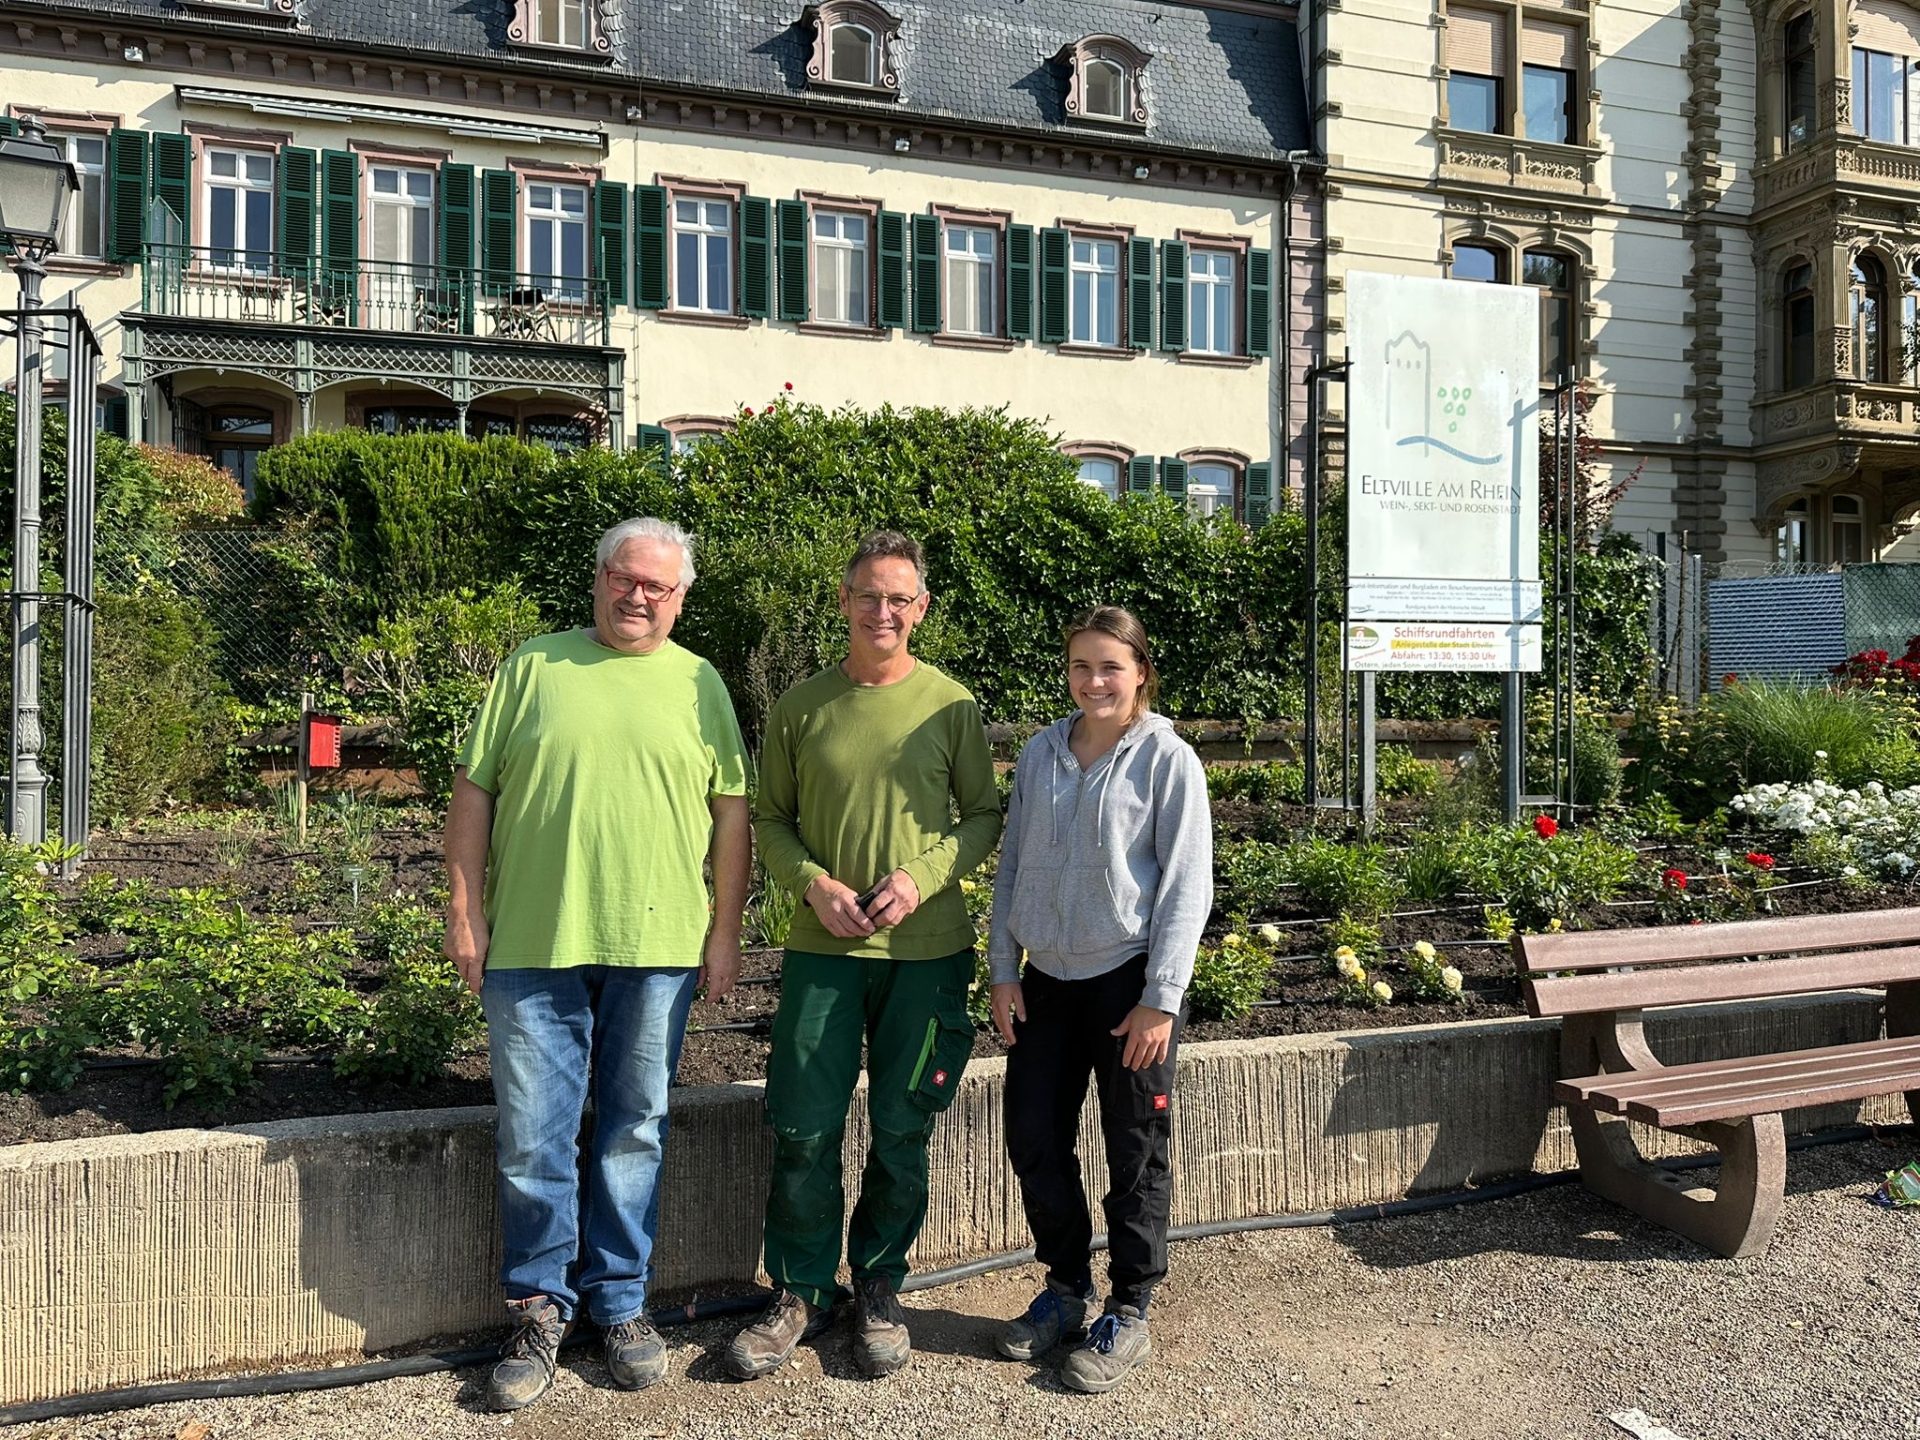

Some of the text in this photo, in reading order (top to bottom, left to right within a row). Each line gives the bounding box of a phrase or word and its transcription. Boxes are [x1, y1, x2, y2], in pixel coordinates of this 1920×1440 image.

[1413, 501, 1437, 512] SEKT-
[1440, 502, 1462, 513] UND
[1464, 503, 1522, 515] ROSENSTADT
[1394, 626, 1495, 638] Schiffsrundfahrten
[1396, 641, 1437, 649] Anlegestelle
[1391, 651, 1426, 660] Abfahrt:
[1429, 652, 1454, 661] 13:30,
[1457, 652, 1480, 660] 15:30
[1482, 652, 1496, 661] Uhr
[1354, 661, 1380, 670] Ostern,
[1382, 661, 1402, 670] jeden
[1438, 662, 1466, 670] Feiertag
